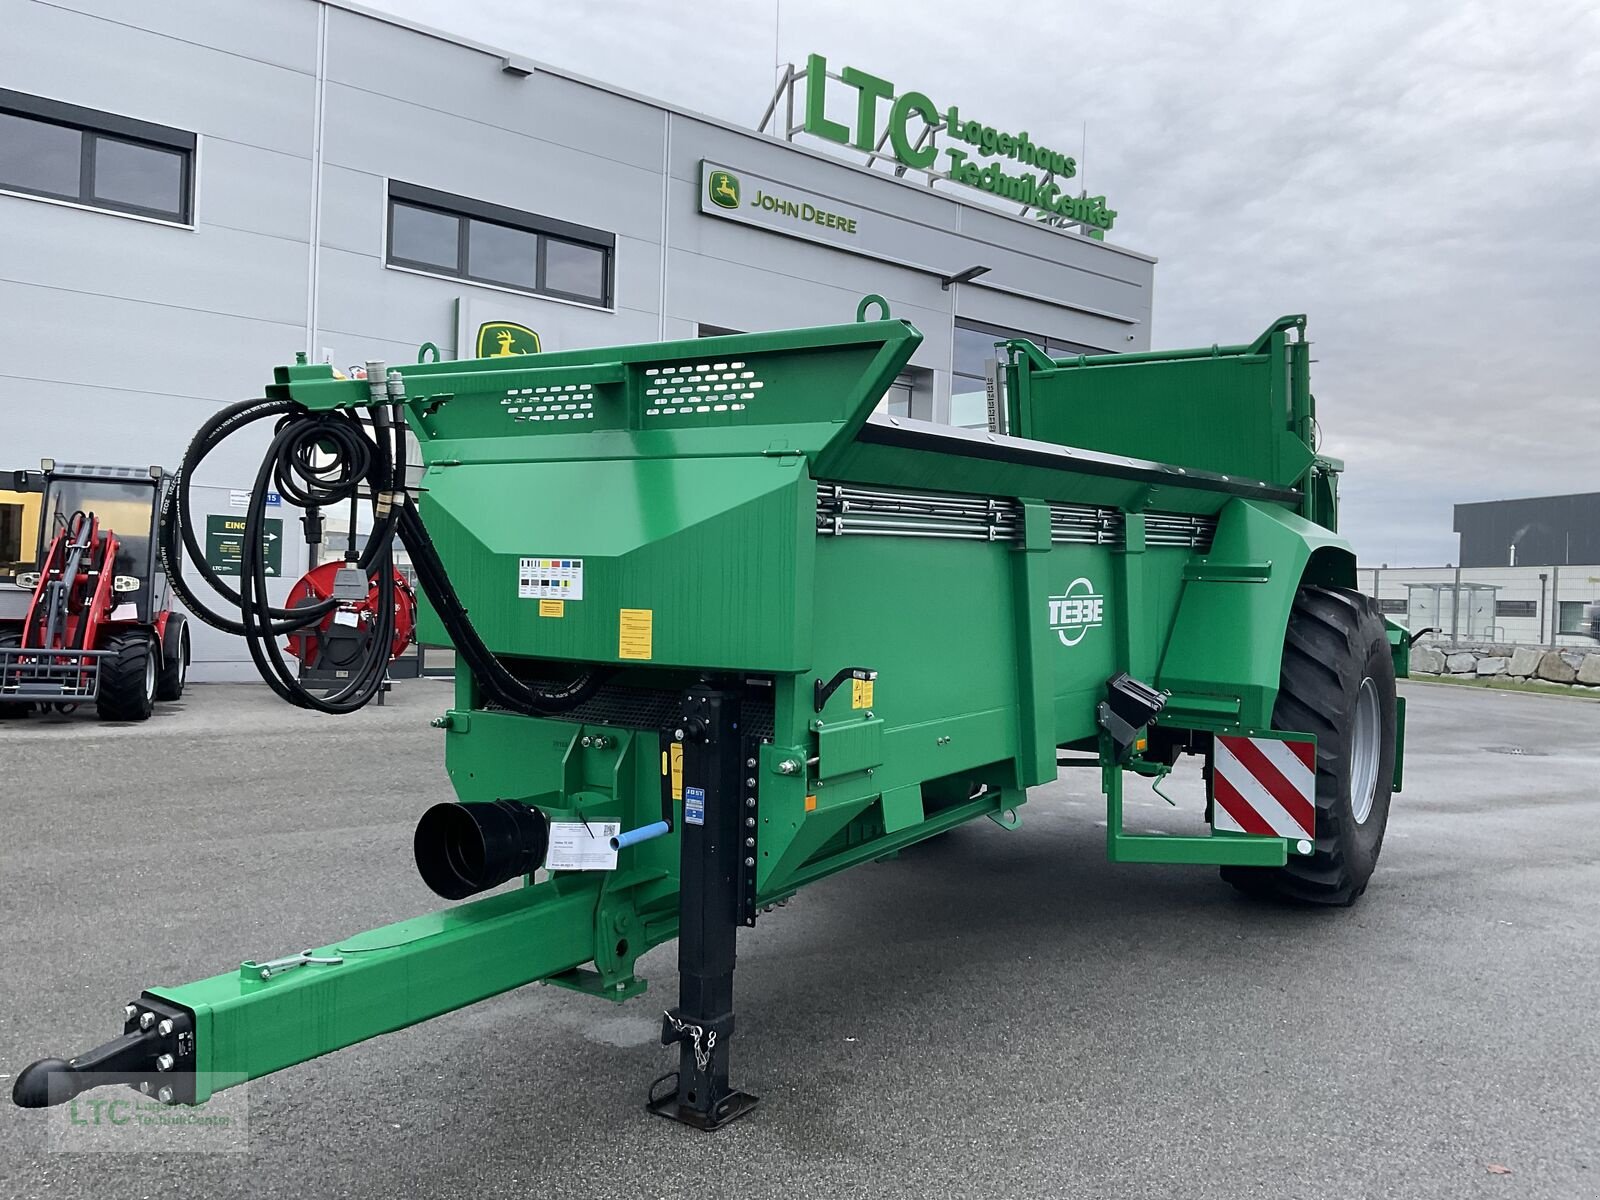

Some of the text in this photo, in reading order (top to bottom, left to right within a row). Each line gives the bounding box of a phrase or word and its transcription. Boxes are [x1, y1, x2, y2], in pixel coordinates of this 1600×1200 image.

[805, 53, 939, 169] LTC
[947, 106, 1076, 179] Lagerhaus
[751, 190, 857, 234] JOHN DEERE
[945, 148, 1117, 231] TechnikCenter
[1048, 599, 1103, 625] TEBBE
